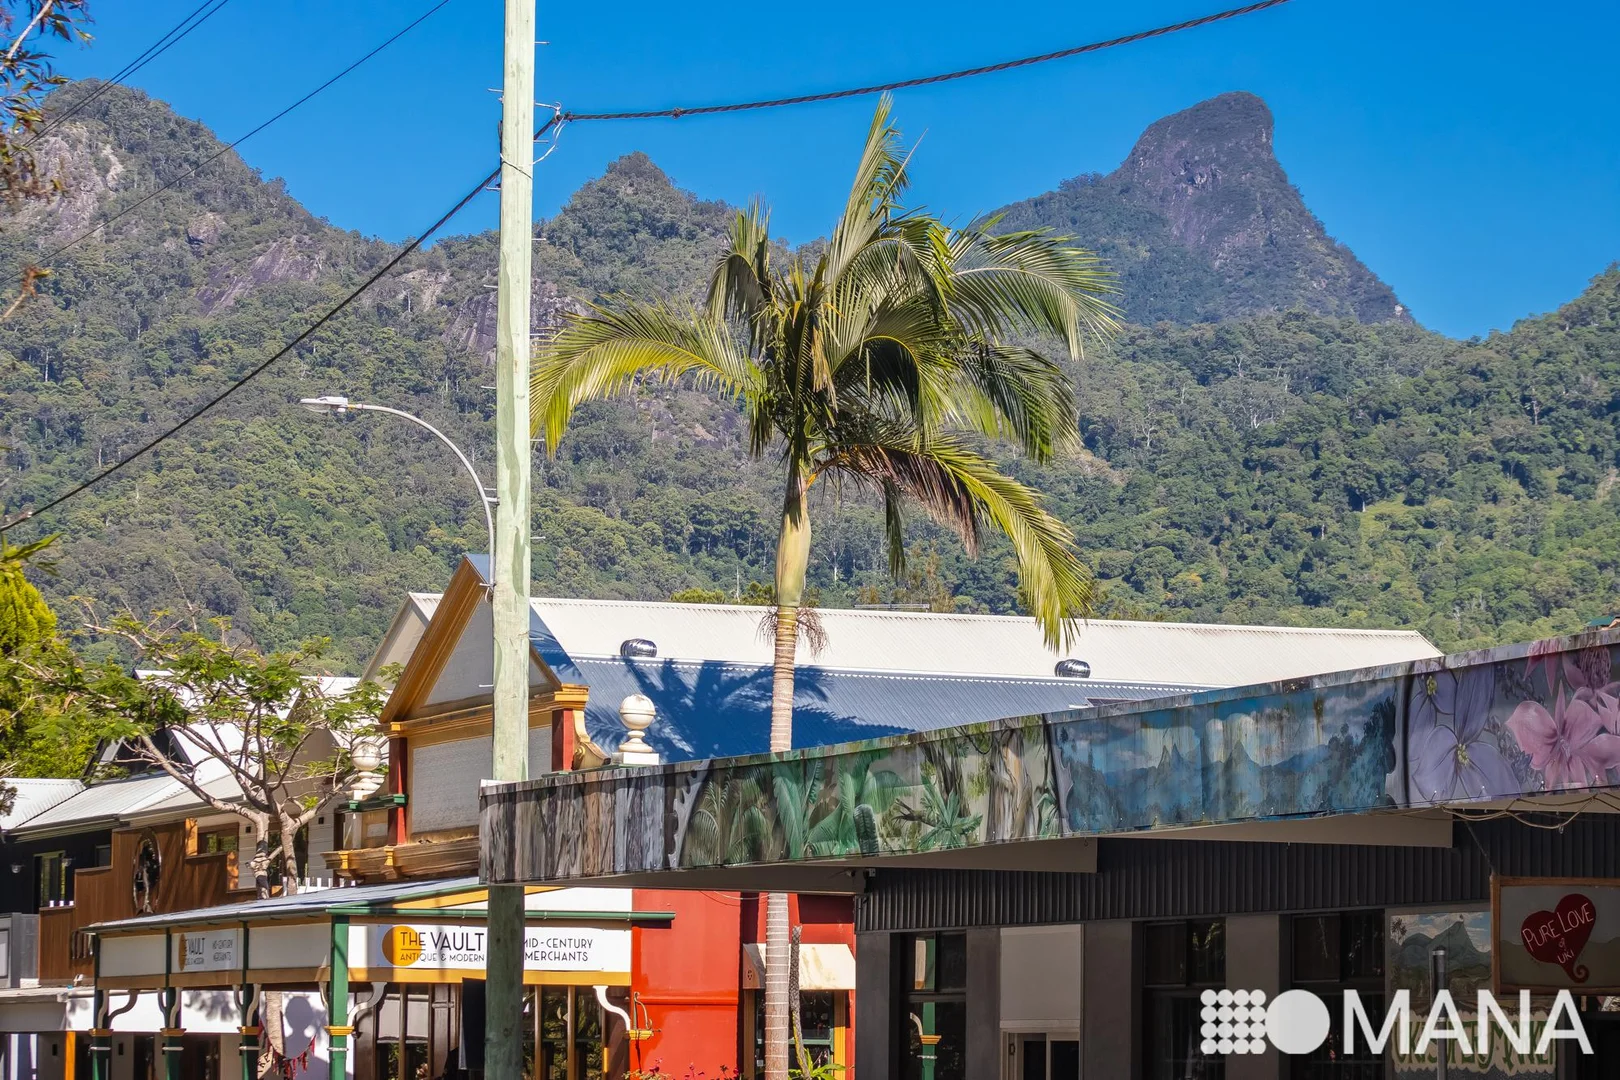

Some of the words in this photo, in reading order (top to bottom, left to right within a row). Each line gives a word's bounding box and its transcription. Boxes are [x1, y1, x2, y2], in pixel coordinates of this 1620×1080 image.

[1522, 920, 1560, 952] PURE
[1556, 902, 1594, 932] LOVE
[400, 932, 426, 946] THE
[430, 932, 485, 951] VAULT
[400, 953, 438, 963] ANTIQUE
[440, 953, 447, 962] &
[449, 953, 485, 963] MODERN
[524, 951, 589, 962] MERCHANTS
[1557, 949, 1574, 964] UKI
